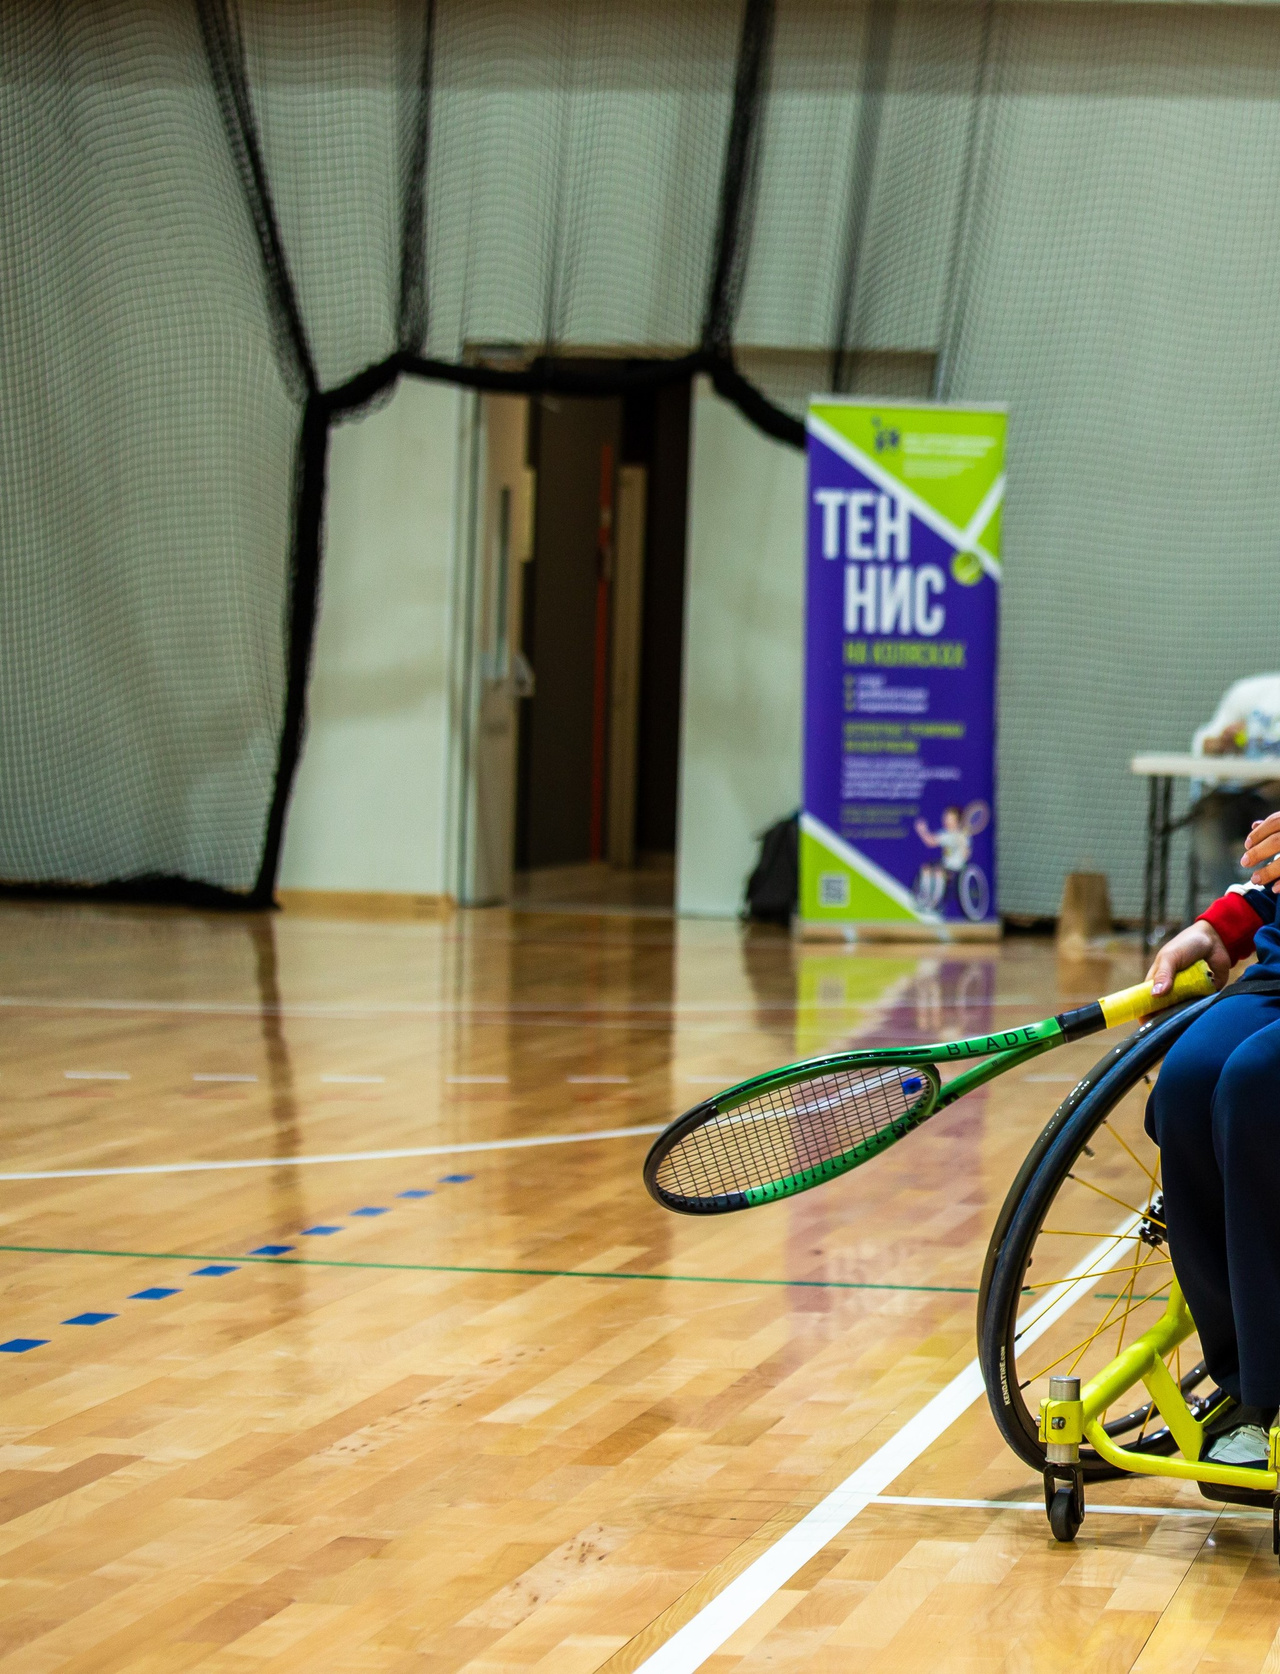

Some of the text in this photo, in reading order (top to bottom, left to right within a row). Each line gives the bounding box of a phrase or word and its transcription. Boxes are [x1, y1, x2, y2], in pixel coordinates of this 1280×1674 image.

[814, 487, 910, 562] ТЕН
[842, 562, 947, 637] НИС
[946, 1026, 1039, 1056] BLADE
